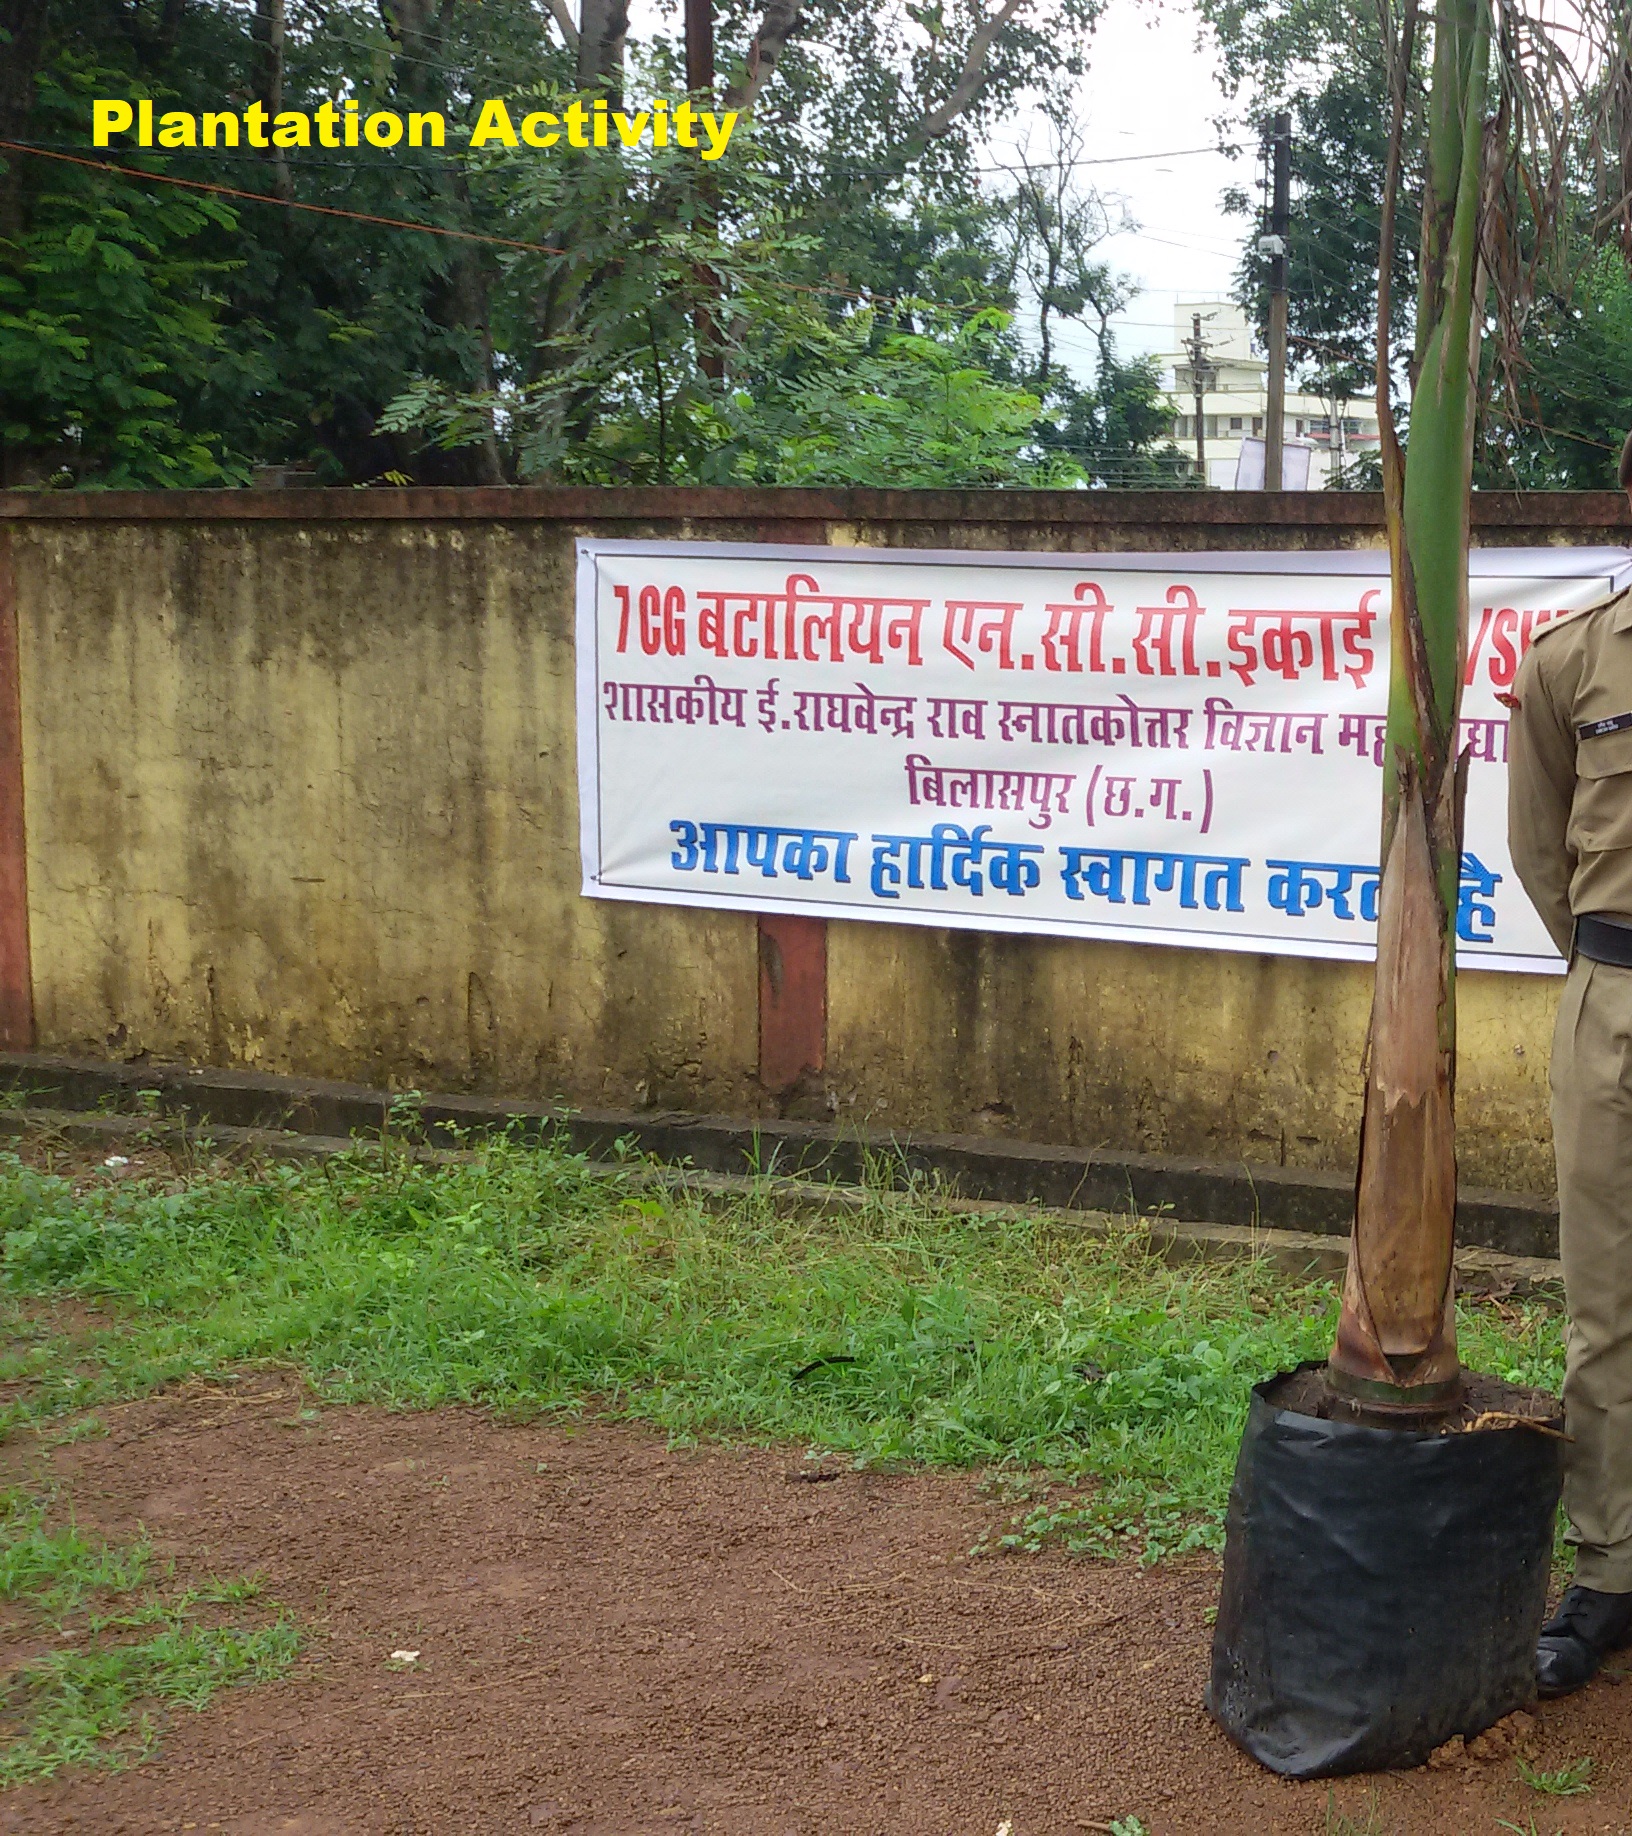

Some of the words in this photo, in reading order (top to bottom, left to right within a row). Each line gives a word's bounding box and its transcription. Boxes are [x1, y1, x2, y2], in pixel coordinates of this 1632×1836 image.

[639, 585, 686, 657] CG
[697, 574, 931, 666] बटालियन
[603, 675, 747, 728] शासकीय
[928, 698, 988, 740] राव
[998, 694, 1193, 750] स्नातकोत्तर
[1204, 697, 1329, 755] विज्ञान
[905, 754, 1077, 830] बिलासपुर
[1086, 764, 1214, 834] (छ.ग.)
[669, 819, 858, 883] आपका
[870, 823, 1044, 898] हार्दिक
[1058, 846, 1251, 912] स्वागत
